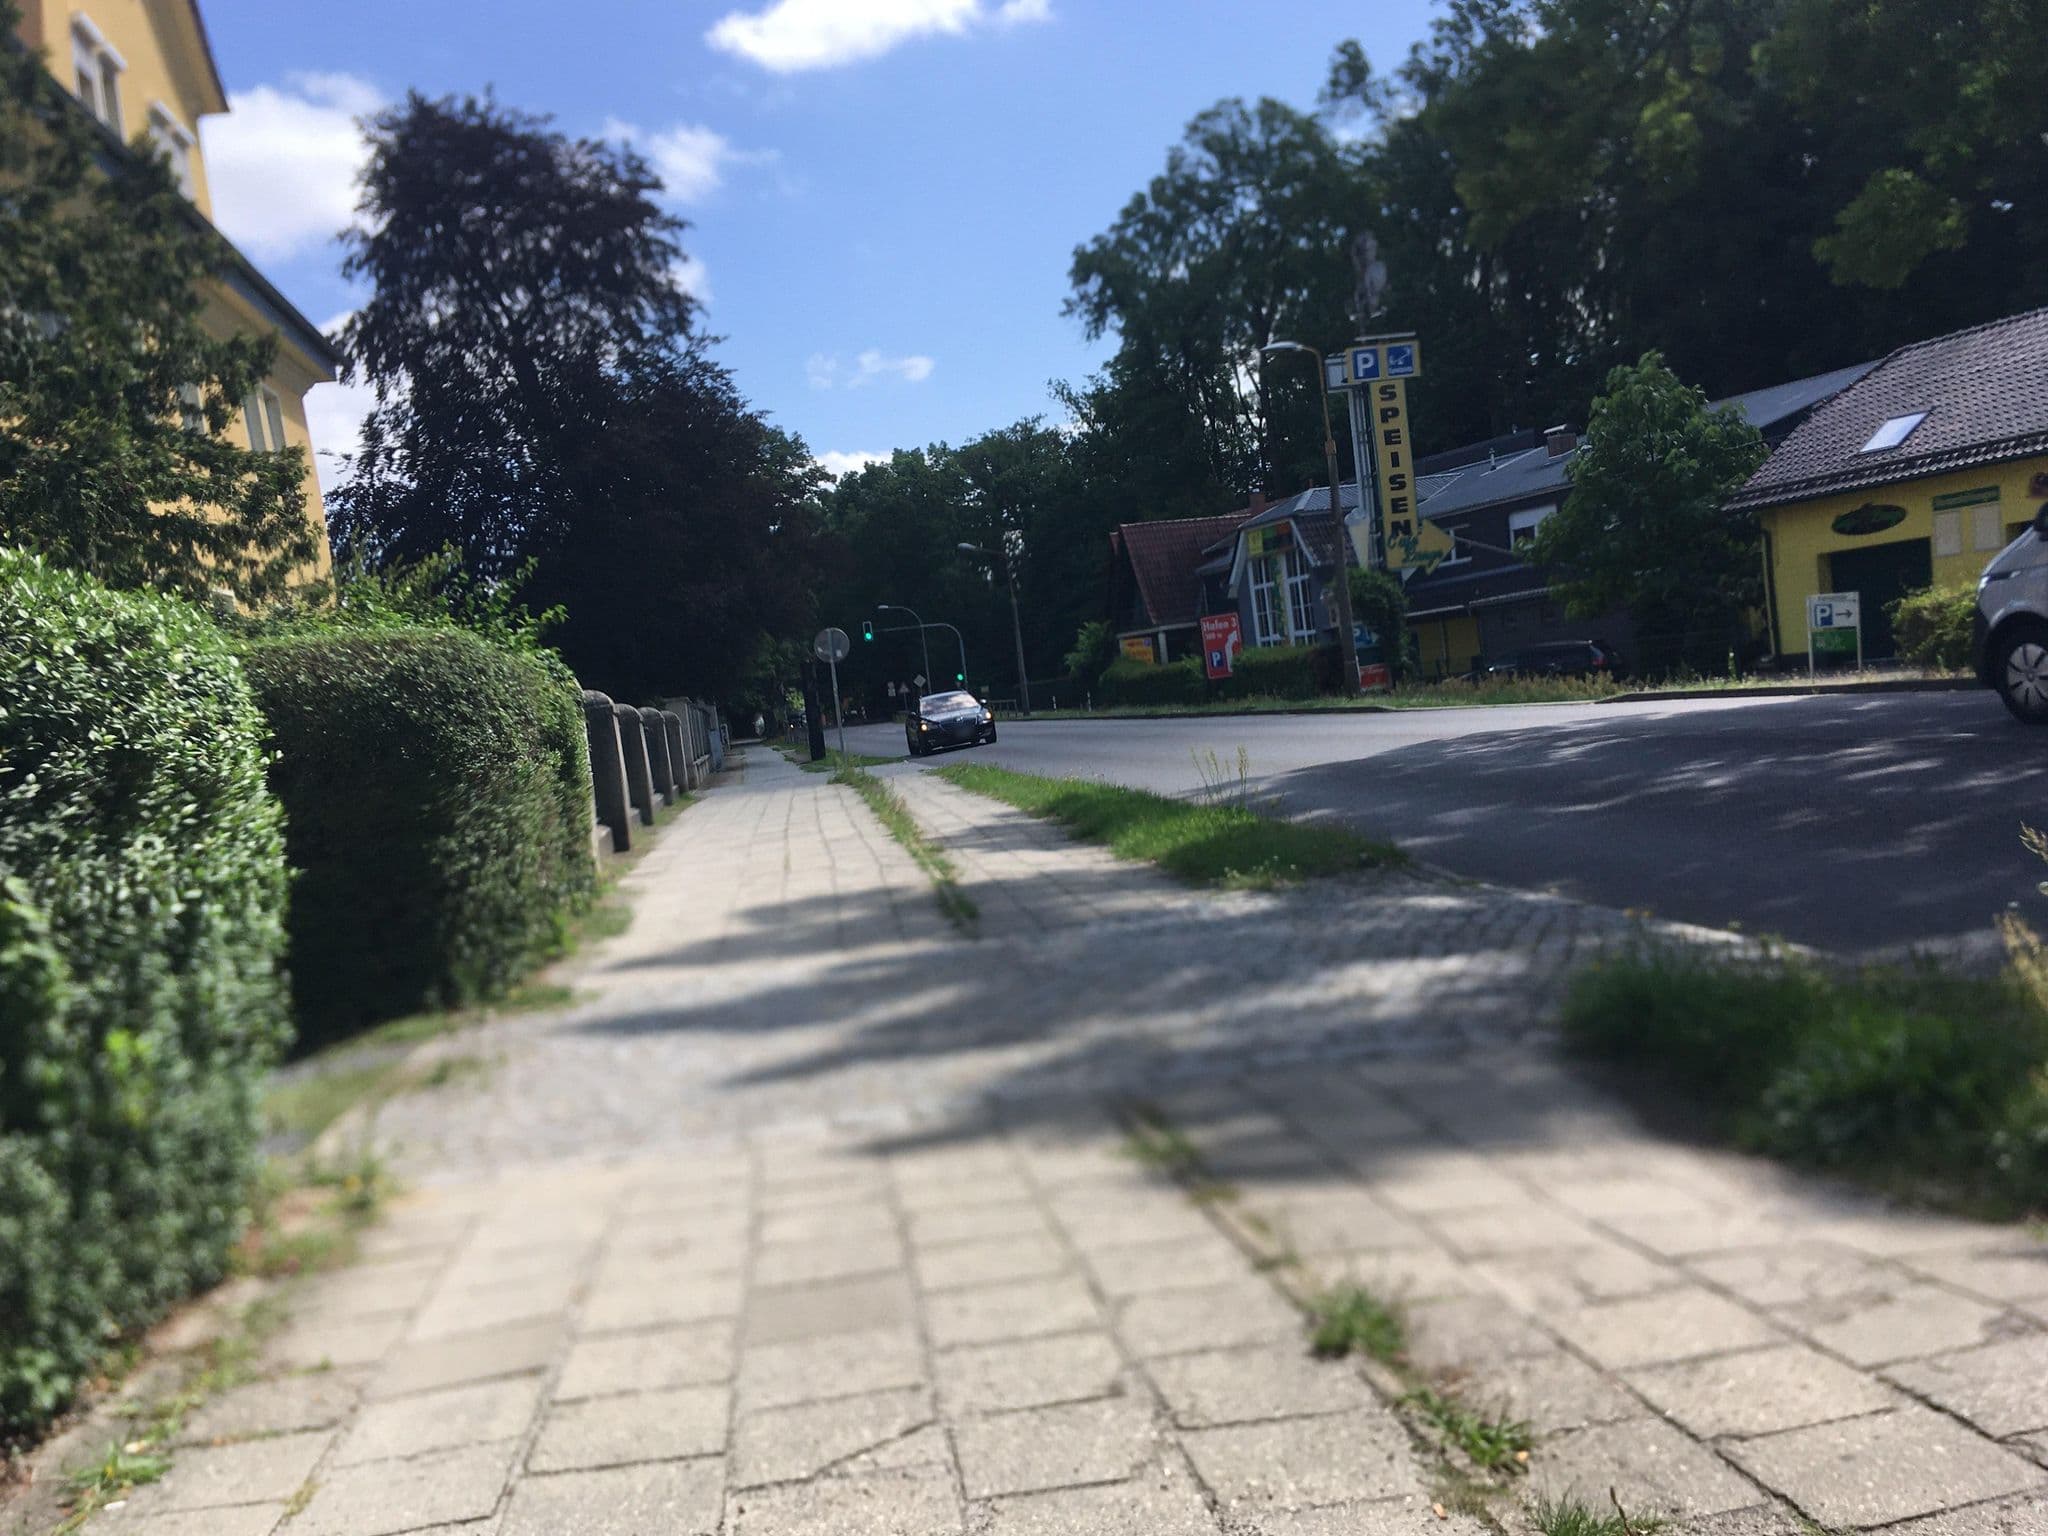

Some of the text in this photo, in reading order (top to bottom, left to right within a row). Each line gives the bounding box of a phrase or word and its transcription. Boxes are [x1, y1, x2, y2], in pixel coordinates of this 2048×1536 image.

[1357, 353, 1374, 377] P
[1379, 384, 1412, 537] SPEISEN
[1816, 605, 1831, 626] P
[1211, 652, 1220, 667] P
